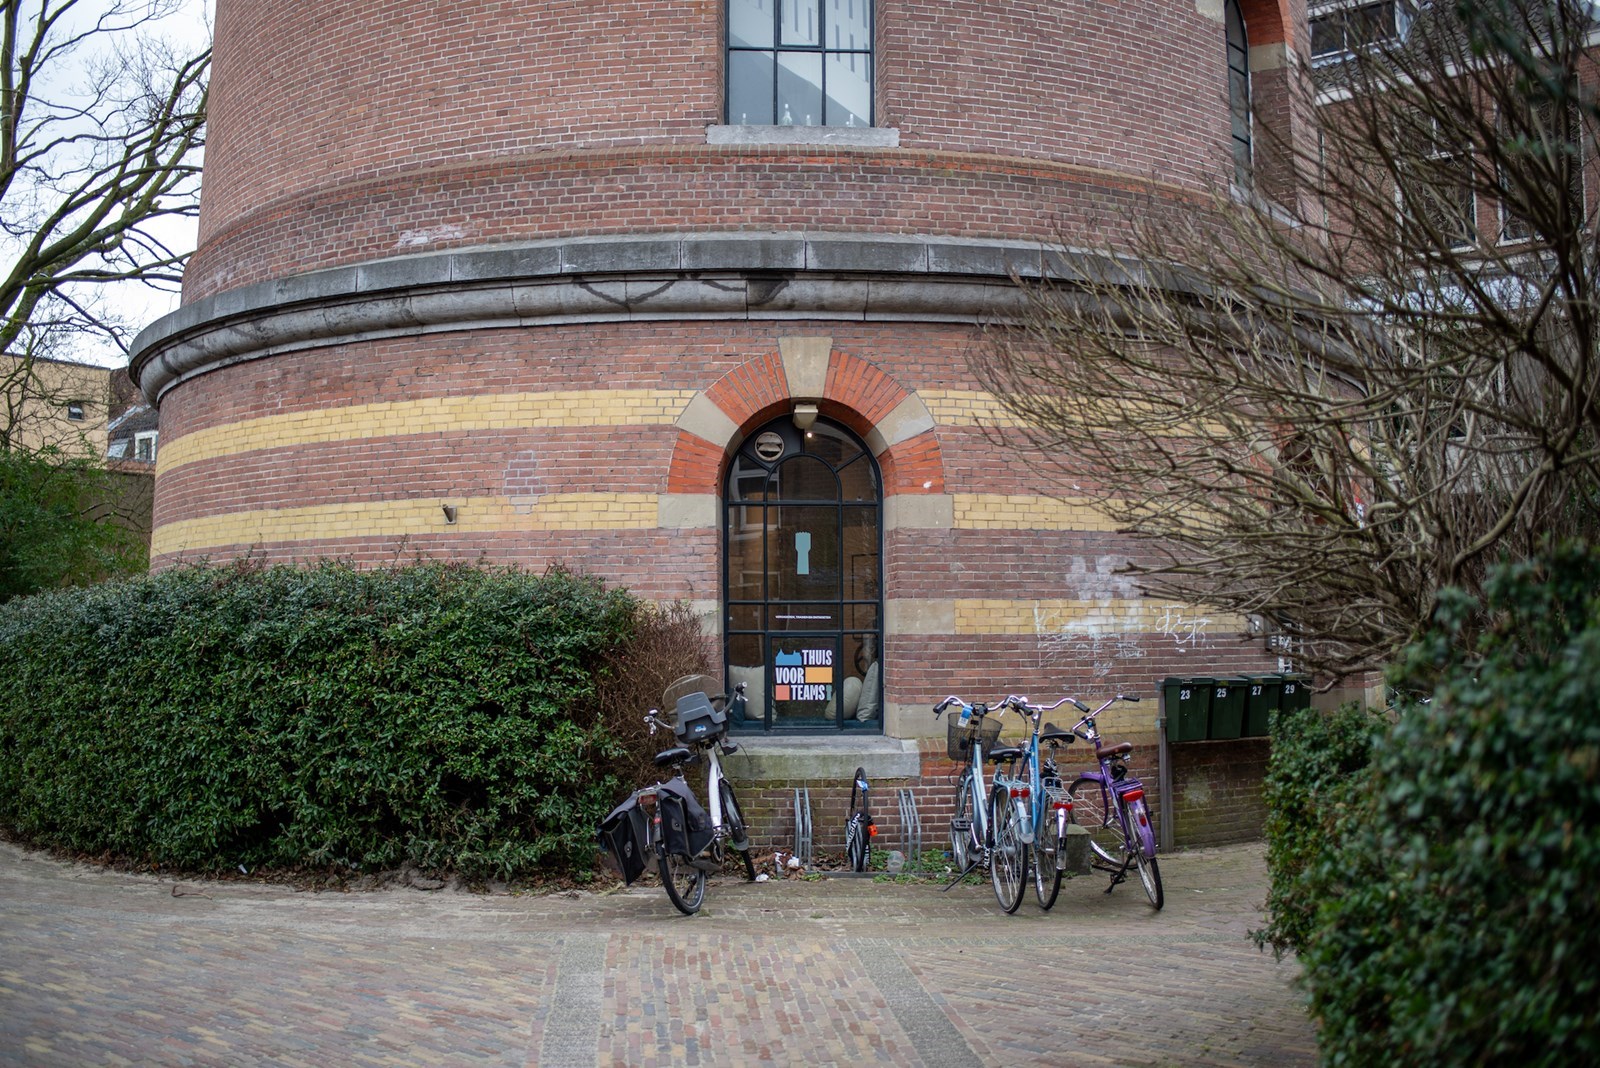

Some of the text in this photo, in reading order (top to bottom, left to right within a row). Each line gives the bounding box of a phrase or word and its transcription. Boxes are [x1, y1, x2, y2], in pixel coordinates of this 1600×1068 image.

[802, 649, 832, 665] THUIS
[775, 667, 804, 684] VOOR
[791, 685, 825, 701] TEAMS
[1217, 688, 1227, 698] 25
[1252, 686, 1262, 695] 27
[1285, 685, 1295, 694] 29
[1180, 690, 1191, 700] 23
